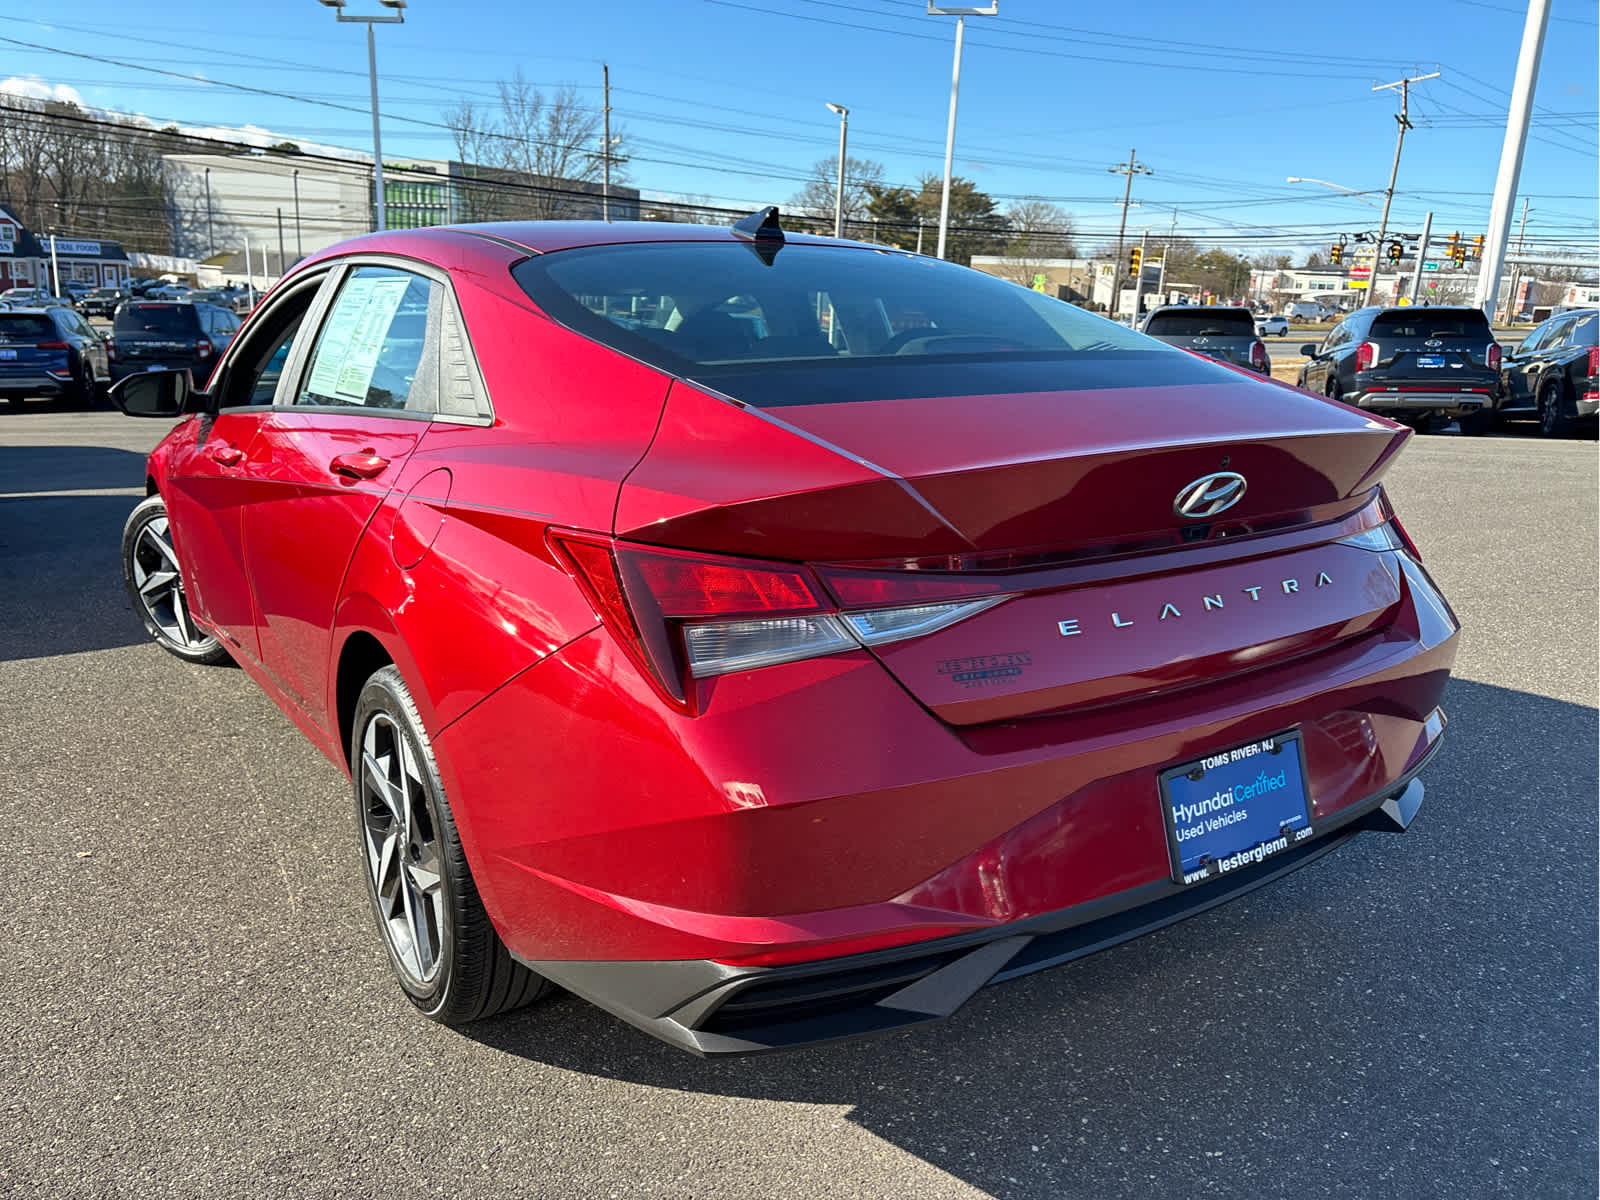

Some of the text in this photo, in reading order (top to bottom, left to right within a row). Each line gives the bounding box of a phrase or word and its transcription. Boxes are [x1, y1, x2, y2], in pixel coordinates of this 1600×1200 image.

[1058, 571, 1333, 636] ELANTRA
[1200, 753, 1229, 771] TOMS
[1262, 739, 1275, 752] NJ
[1172, 769, 1287, 824] Hyundai Certified
[1176, 809, 1248, 842] Used Vehicles
[1218, 837, 1288, 873] lesterglenn
